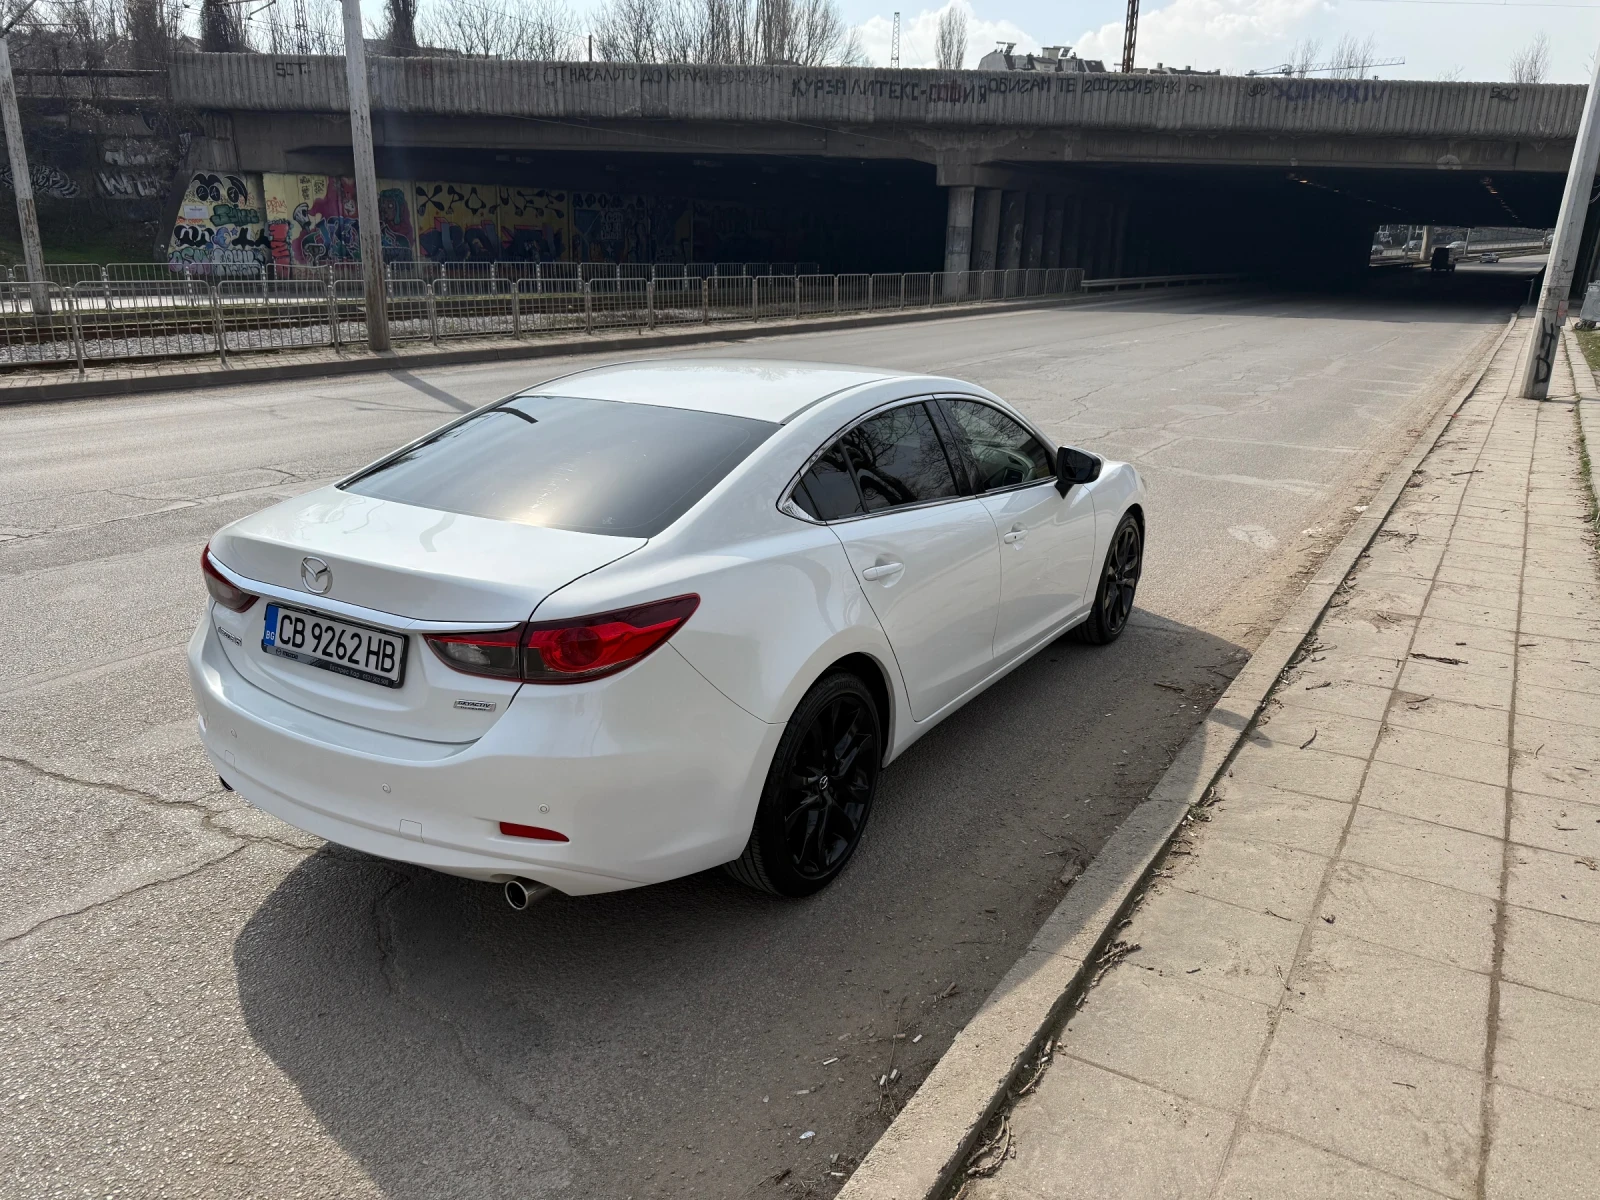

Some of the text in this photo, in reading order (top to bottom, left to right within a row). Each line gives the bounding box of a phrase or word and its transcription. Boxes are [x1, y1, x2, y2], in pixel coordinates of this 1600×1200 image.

[640, 68, 663, 84] ДО
[1056, 77, 1075, 93] ТЕ
[265, 631, 275, 641] BG
[279, 614, 396, 673] CB 9262 HB
[458, 700, 491, 708] SKYACTIV
